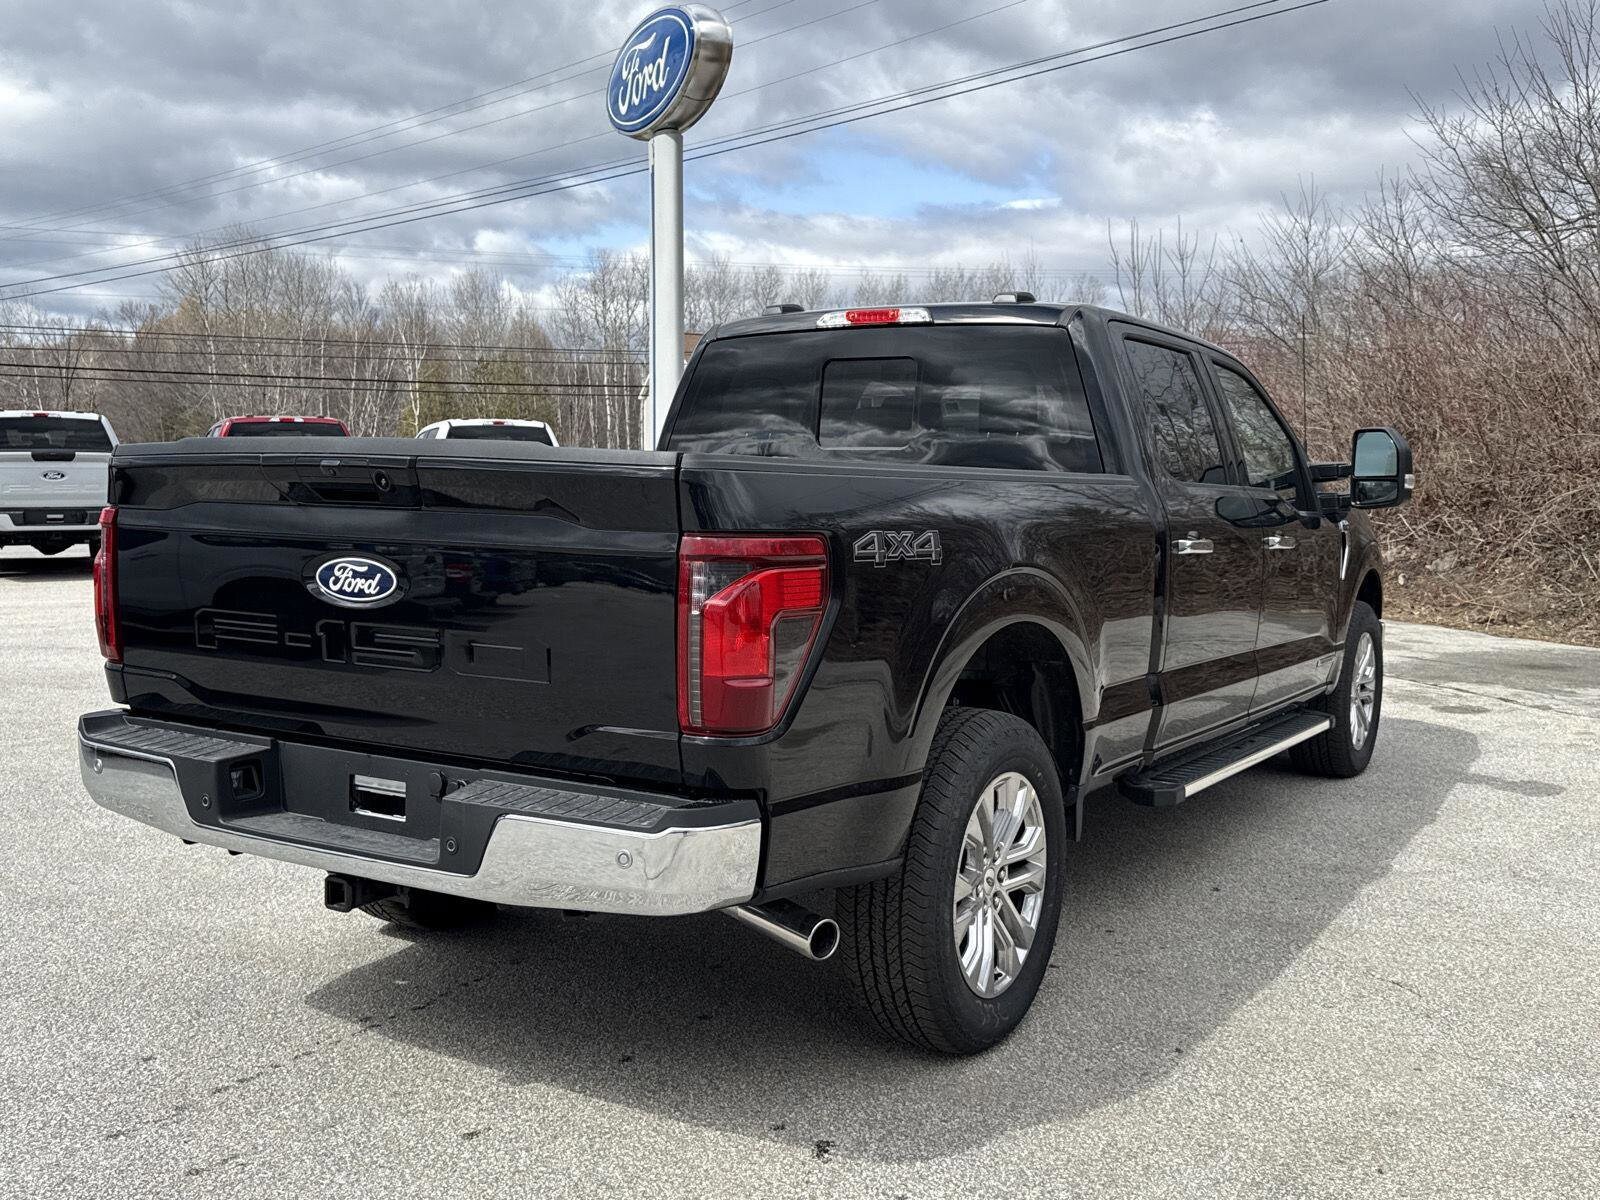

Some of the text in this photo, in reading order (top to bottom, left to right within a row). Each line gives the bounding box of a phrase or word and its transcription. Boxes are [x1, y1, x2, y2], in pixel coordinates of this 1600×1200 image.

[618, 32, 671, 115] Ford
[329, 563, 381, 594] Ford
[194, 608, 552, 686] F-150
